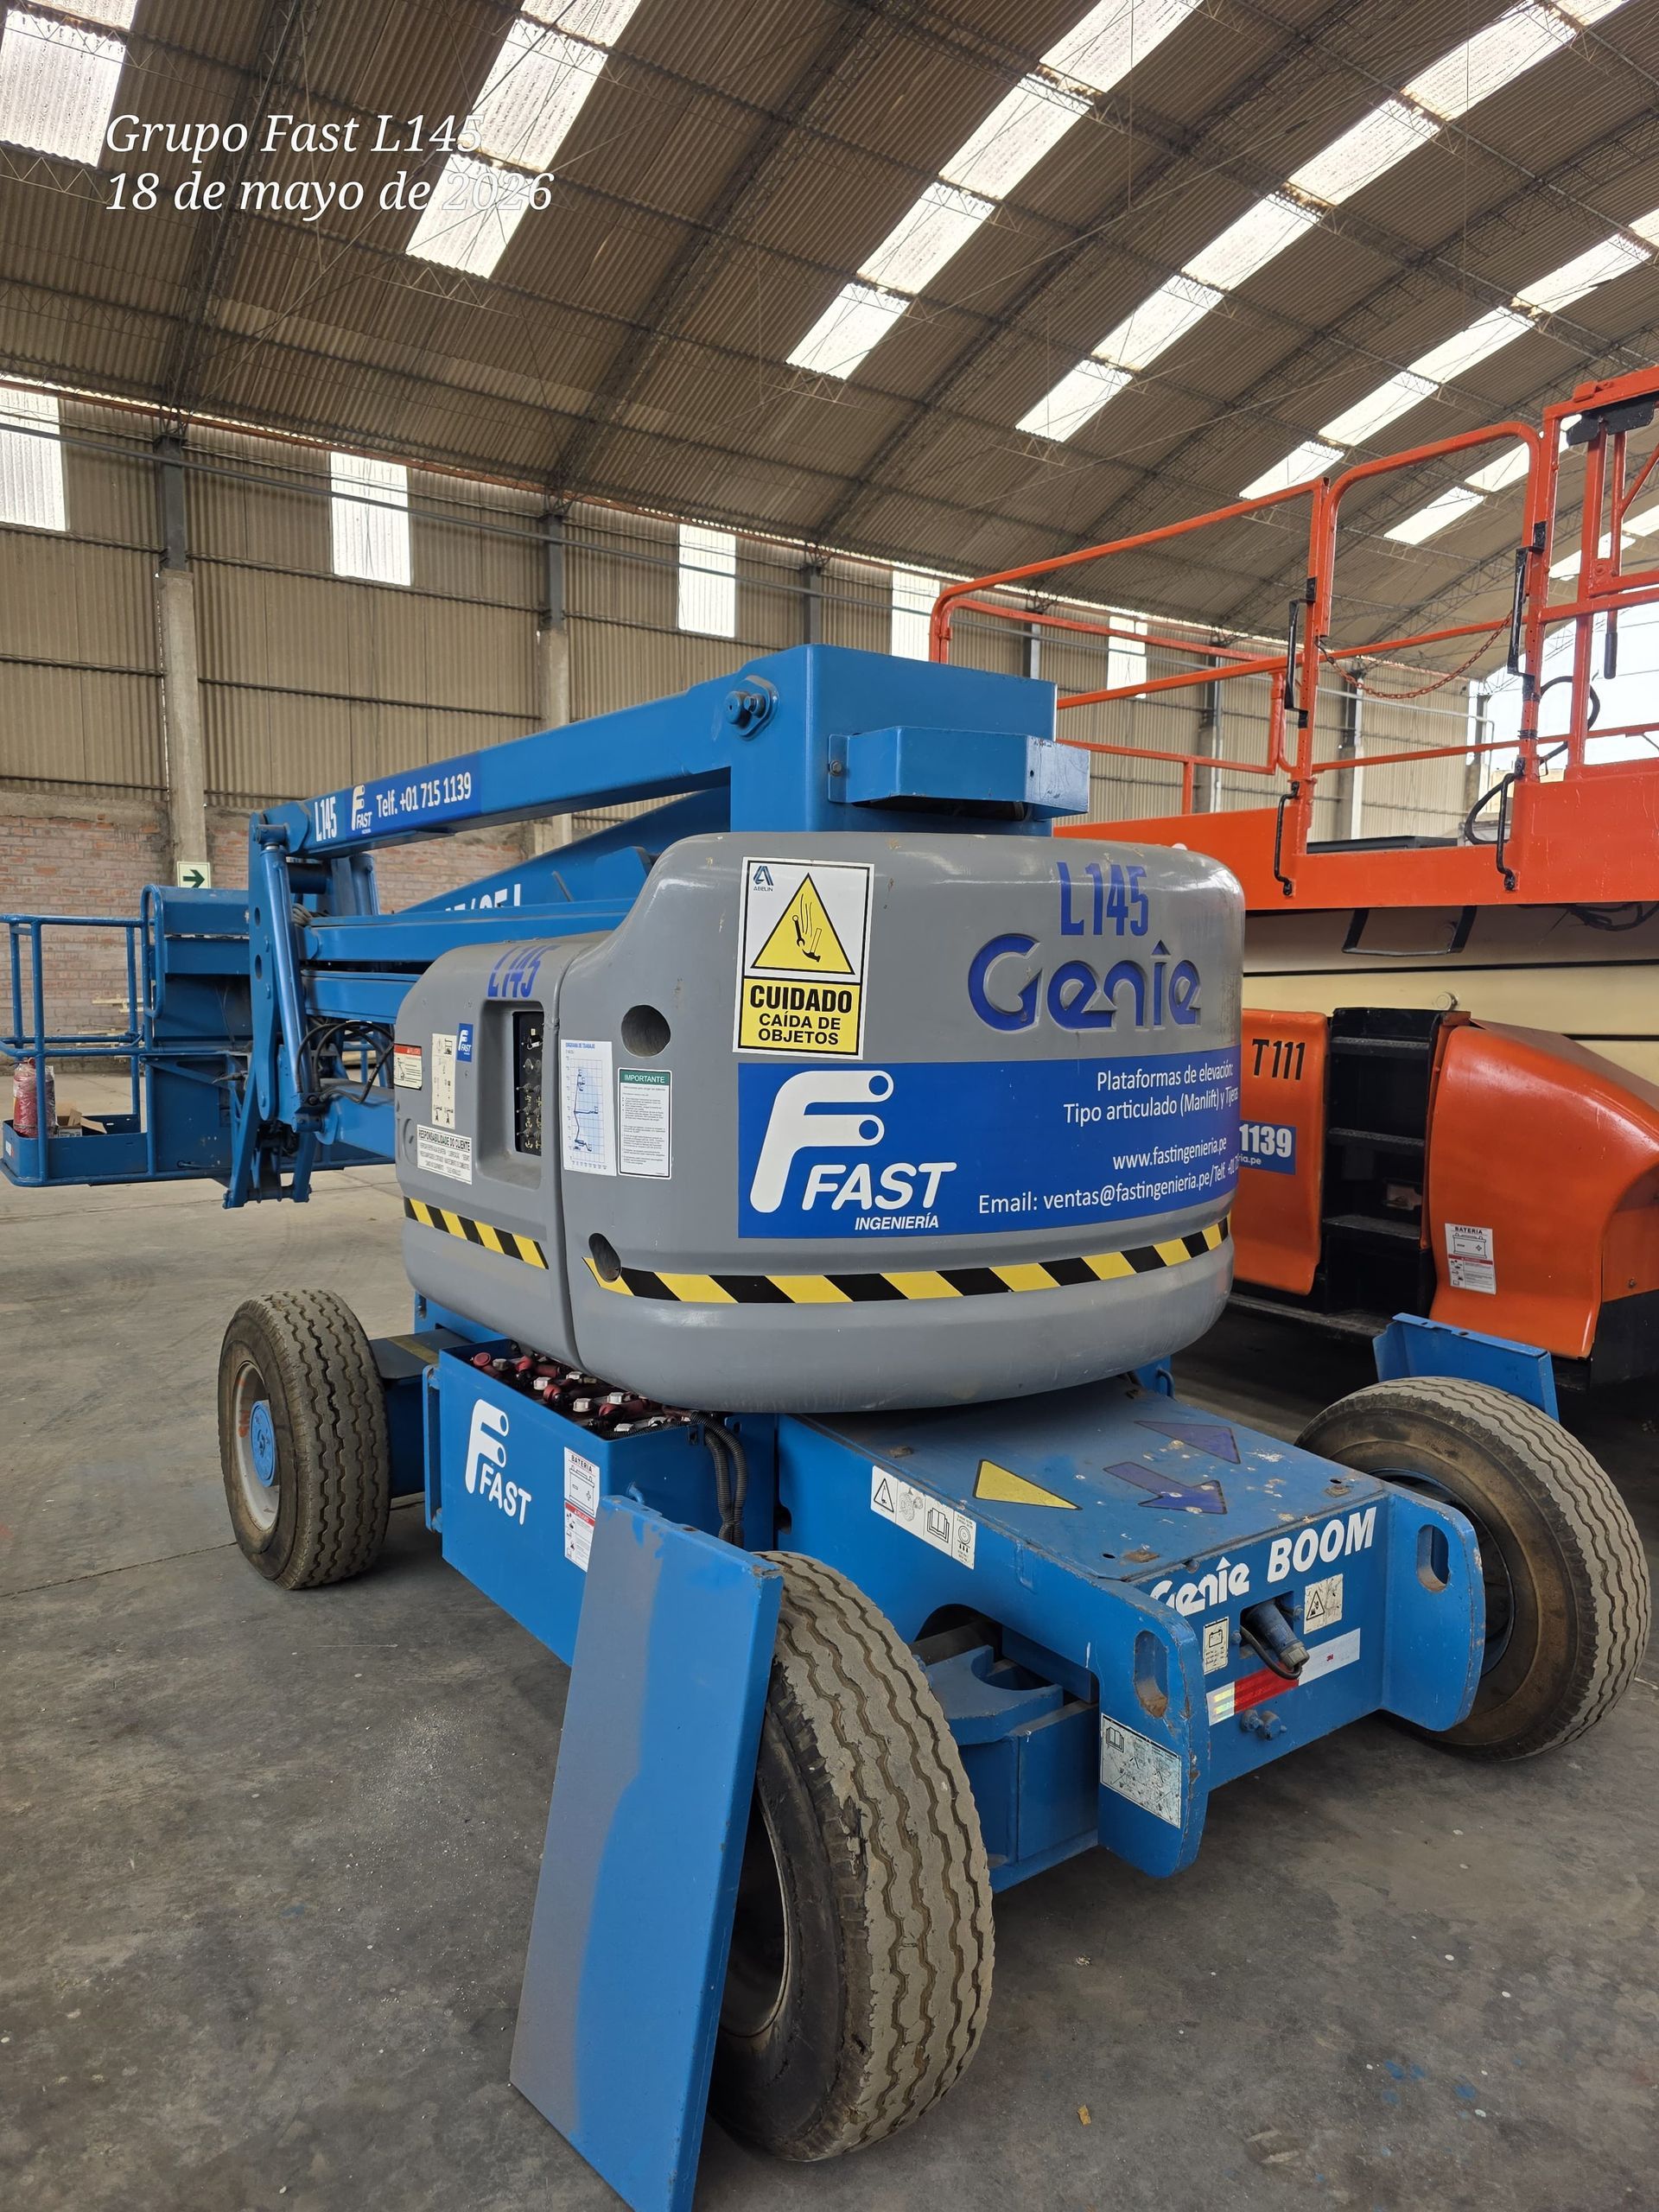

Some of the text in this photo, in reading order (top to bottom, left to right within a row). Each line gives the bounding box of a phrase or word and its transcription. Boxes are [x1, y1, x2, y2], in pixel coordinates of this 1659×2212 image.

[376, 772, 472, 818] Telf. +01 715 1139
[315, 796, 337, 842] L145
[356, 811, 372, 830] FAST
[1056, 861, 1149, 937] L145
[487, 944, 561, 998] L145
[968, 933, 1202, 1033] Genie
[750, 984, 852, 1014] CUIDADO
[758, 1027, 838, 1046] OBJETOS
[759, 1011, 841, 1031] CAÍDA DE
[1097, 1059, 1233, 1091] Plataformas de elevación:
[1252, 1038, 1306, 1081] T111
[624, 1074, 665, 1084] IMPORTANTE
[1063, 1103, 1102, 1127] Tipo
[1107, 1095, 1177, 1121] articulado
[1180, 1088, 1219, 1117] (Manlift)
[1220, 1091, 1224, 1110] y
[1113, 1137, 1227, 1170] www.fastingenieria.pe
[1239, 1123, 1293, 1158] 1139
[802, 1162, 957, 1211] FAST
[979, 1191, 1038, 1214] Email:
[855, 1212, 939, 1230] INGENIERÍA
[1454, 1226, 1483, 1235] BATERIA
[570, 1454, 593, 1474] BATERIA
[480, 1462, 532, 1526] FAST
[1268, 1506, 1377, 1584] BOOM
